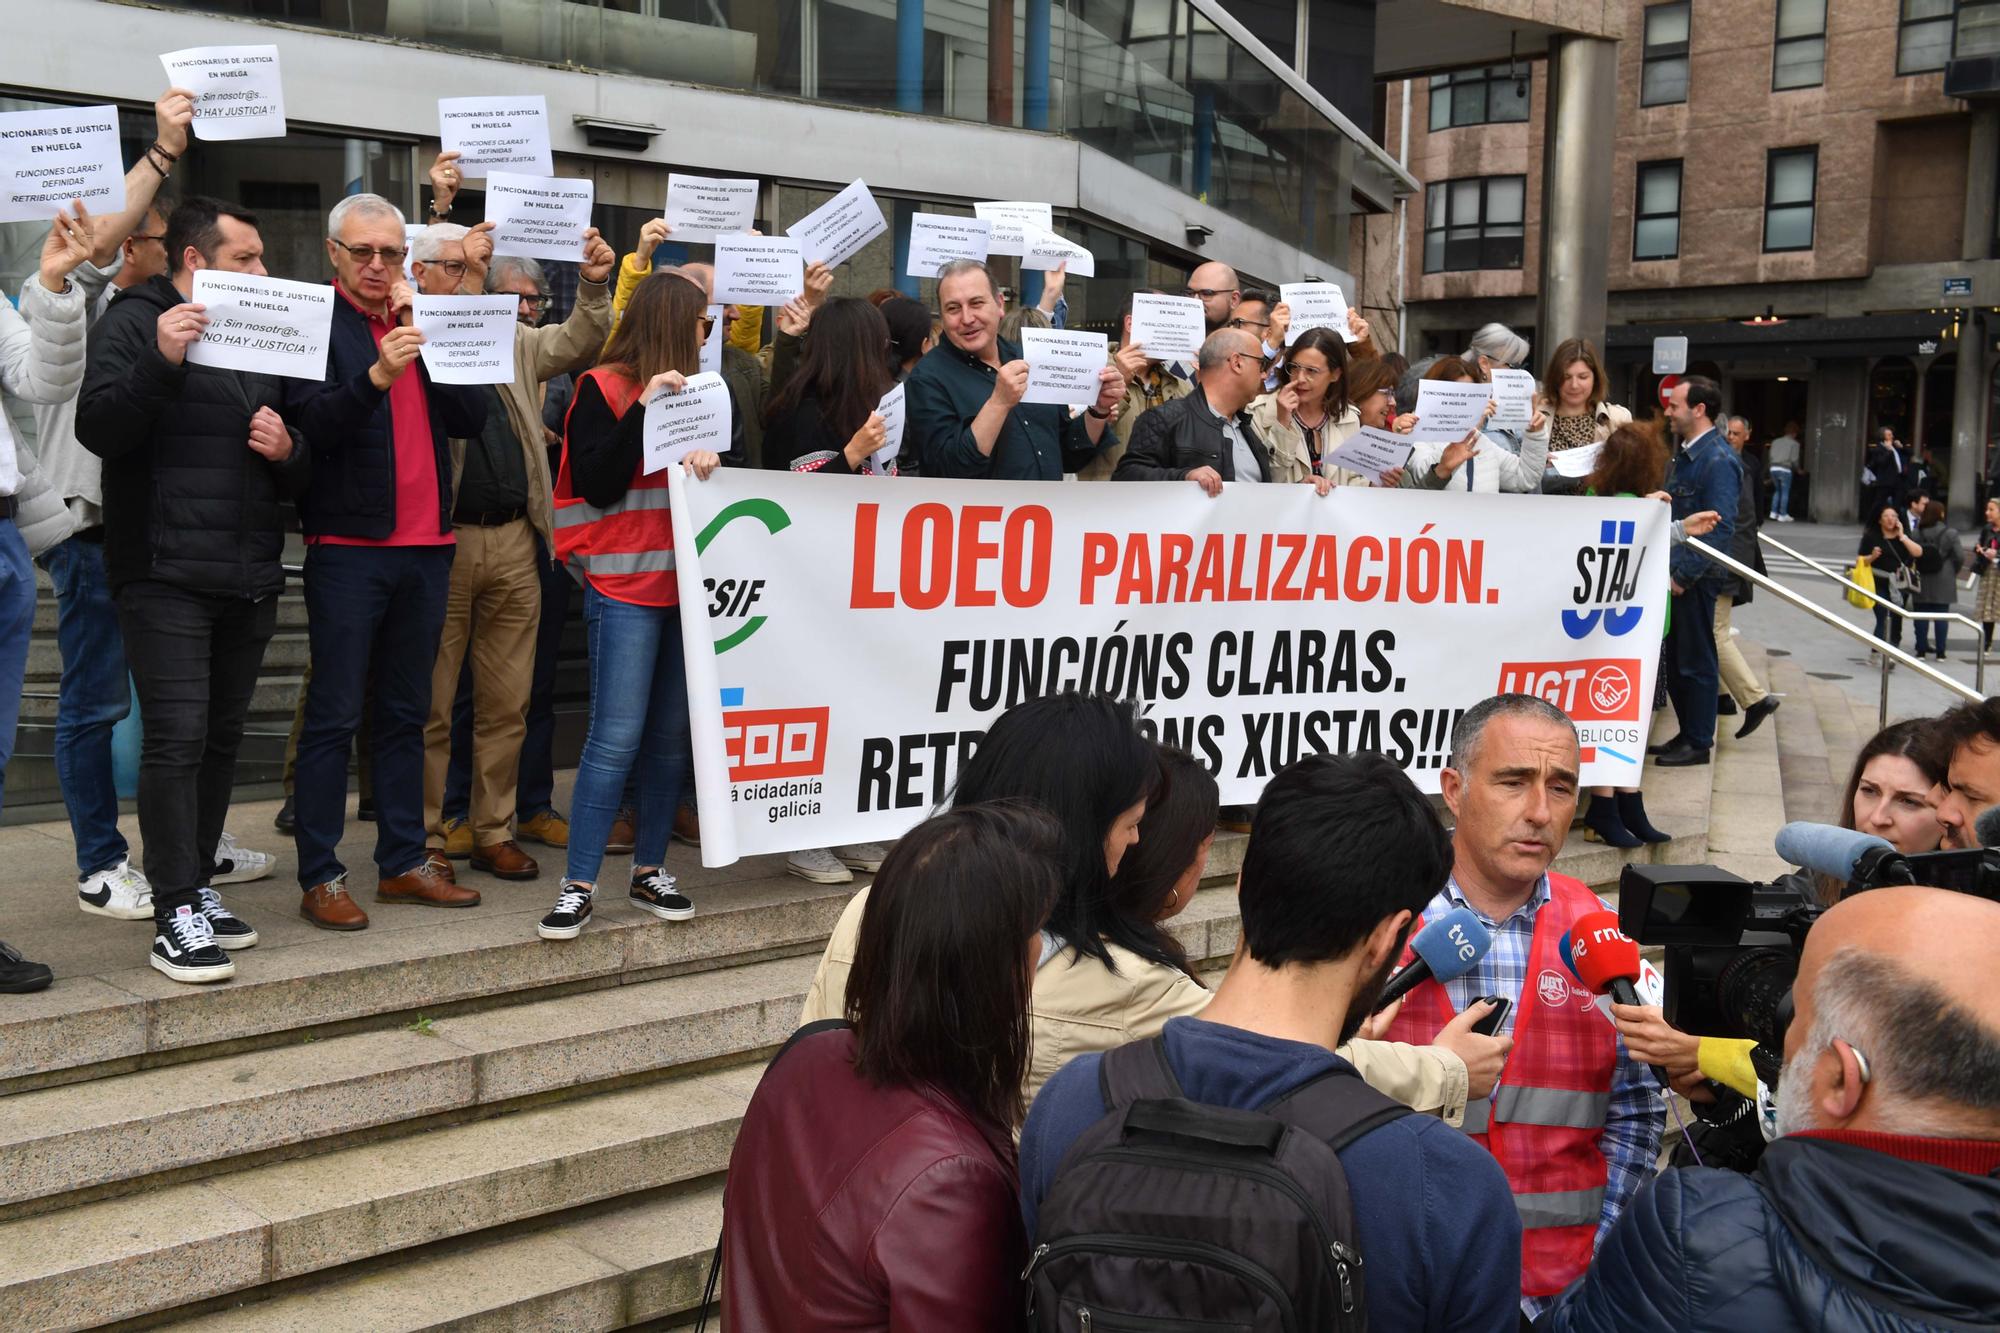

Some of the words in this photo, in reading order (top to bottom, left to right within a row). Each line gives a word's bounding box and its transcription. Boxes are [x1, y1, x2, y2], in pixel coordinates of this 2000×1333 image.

[203, 93, 215, 101] Sin
[204, 108, 224, 117] HAY
[225, 106, 267, 116] JUSTICIA
[0, 128, 58, 138] NCIONARI@S
[75, 124, 112, 133] JUSTICIA
[31, 145, 43, 153] EN
[46, 142, 81, 151] HUELGA
[15, 167, 65, 178] FUNCIONES
[66, 164, 96, 174] CLARAS
[97, 164, 103, 172] Y
[42, 177, 85, 188] DEFINIDAS
[11, 191, 81, 202] RETRIBUCIONES
[83, 188, 109, 197] JUSTAS
[500, 235, 552, 244] RETRIBUCIONES
[287, 292, 325, 303] JUSTICIA
[254, 302, 289, 312] HUELGA
[224, 319, 242, 328] Sin
[203, 332, 222, 342] NO
[224, 335, 250, 346] HAY
[251, 338, 305, 353] JUSTICIA
[698, 381, 721, 392] JUSTICIA
[675, 399, 702, 408] HUELGA
[657, 419, 685, 432] FUNCIONES
[686, 414, 710, 423] CLARAS
[668, 425, 699, 436] DEFINIDAS
[655, 435, 694, 452] RETRIBUCIONES
[695, 431, 718, 440] JUSTAS
[850, 503, 1053, 609] LOEO
[1080, 523, 1500, 605] PARALIZACIÓN.
[935, 620, 1193, 713] FUNCIÓNS
[1207, 629, 1406, 697] CLARAS.
[1577, 728, 1639, 743] BLICOS
[744, 777, 822, 801] cidadanía
[768, 800, 821, 822] galicia
[1448, 923, 1476, 961] tve
